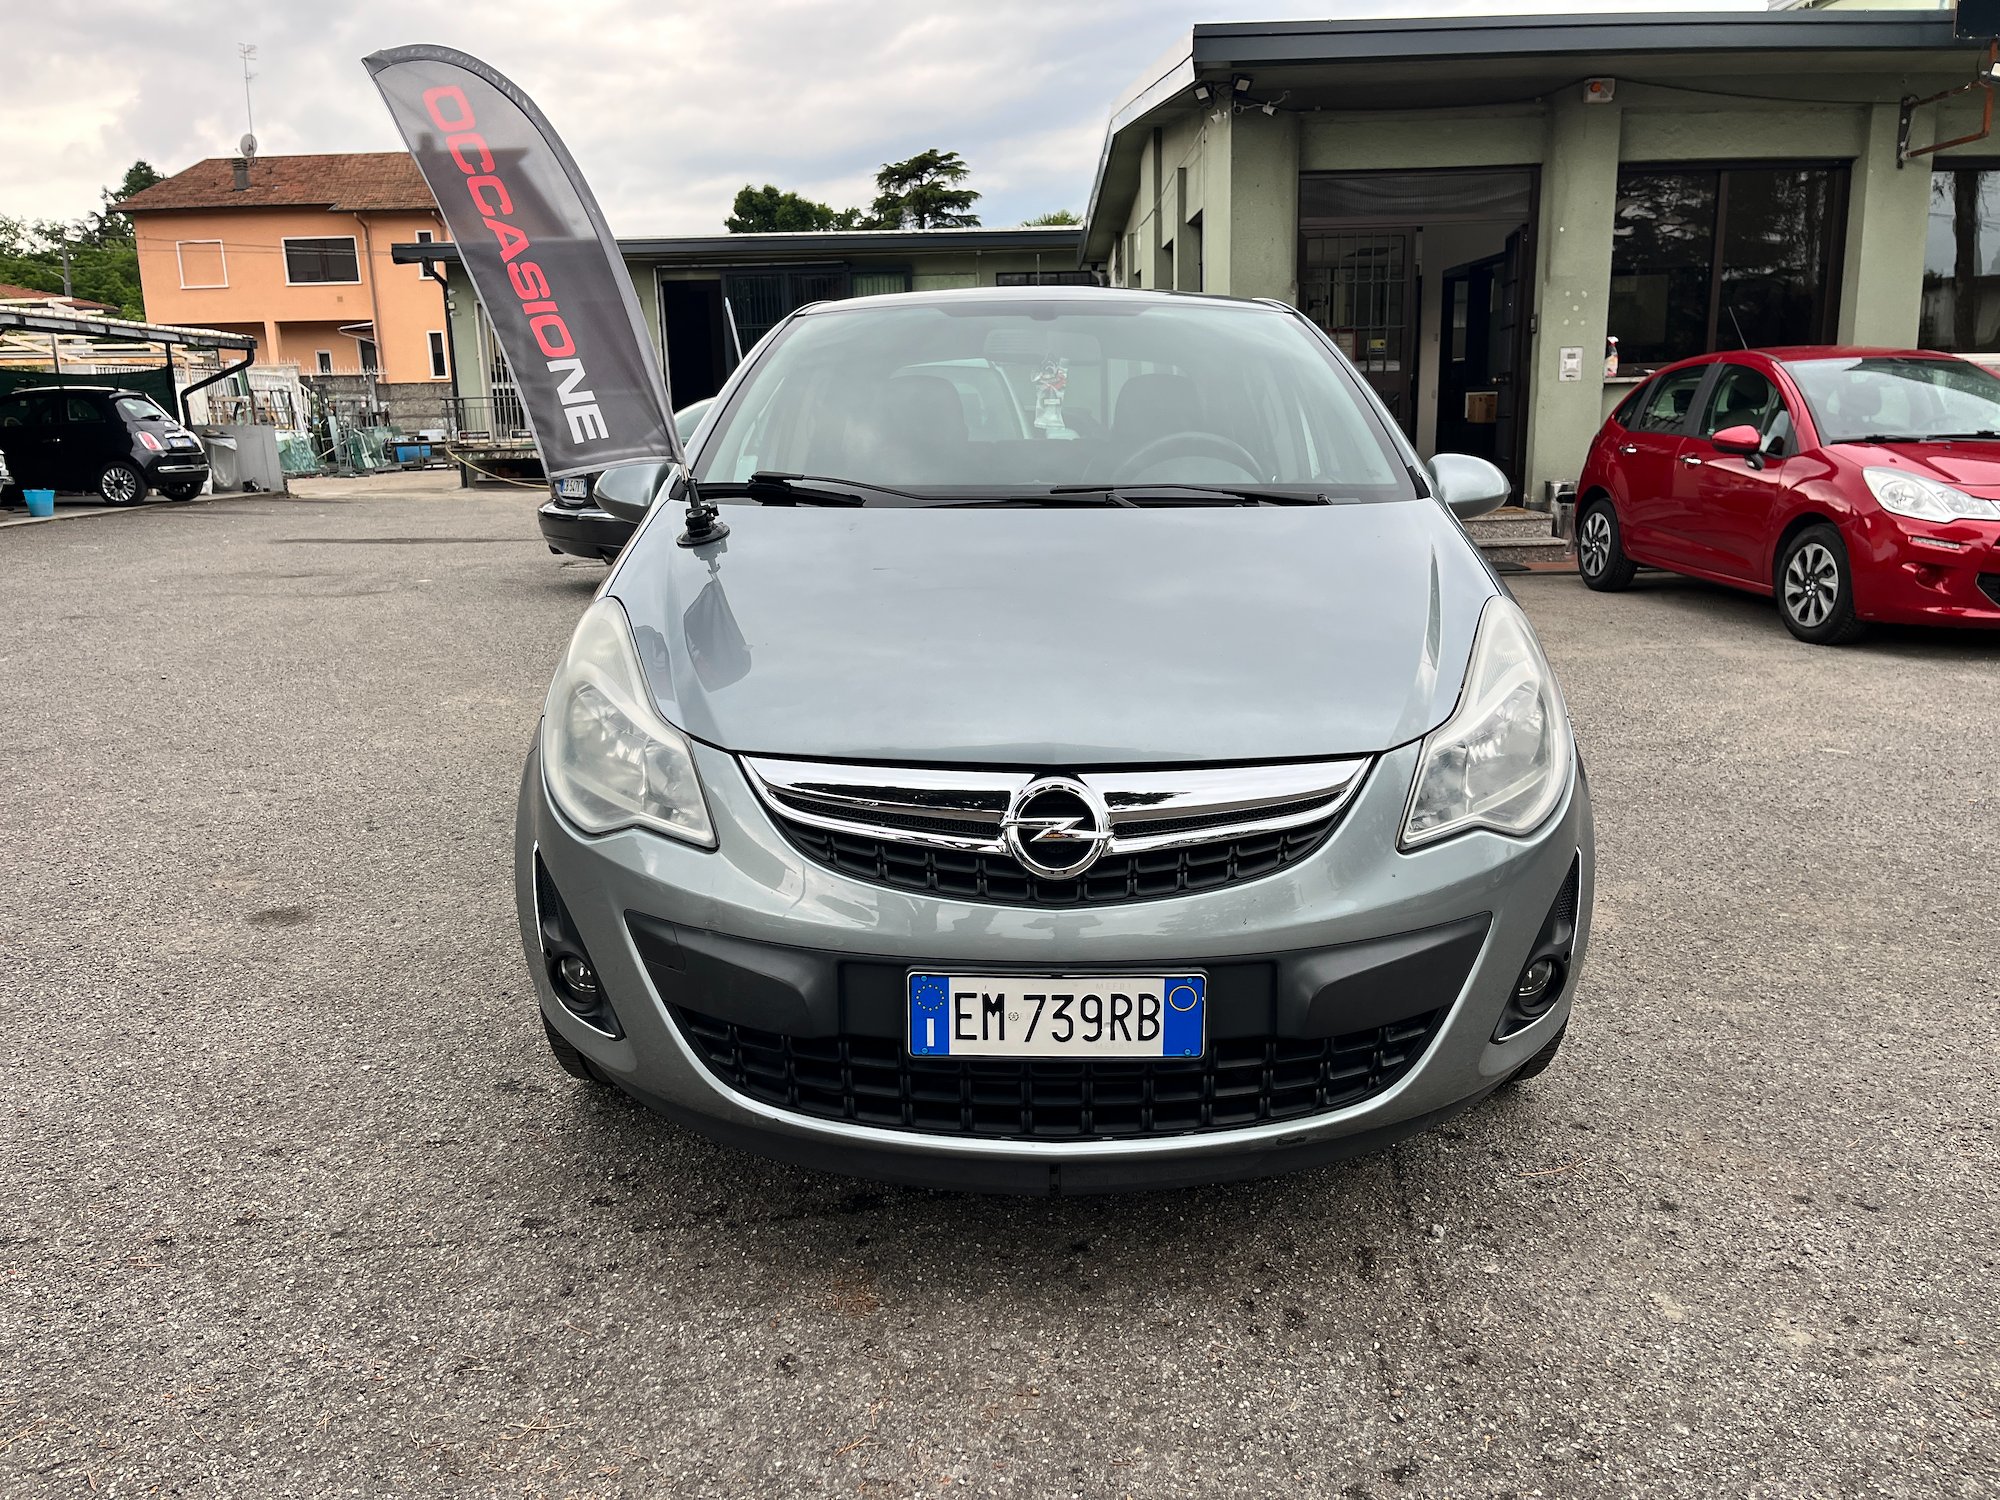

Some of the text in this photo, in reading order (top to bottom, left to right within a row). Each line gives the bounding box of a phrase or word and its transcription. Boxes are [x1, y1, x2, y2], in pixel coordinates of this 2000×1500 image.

[422, 85, 610, 445] OCCASIONE
[955, 992, 1161, 1043] EM 739RB
